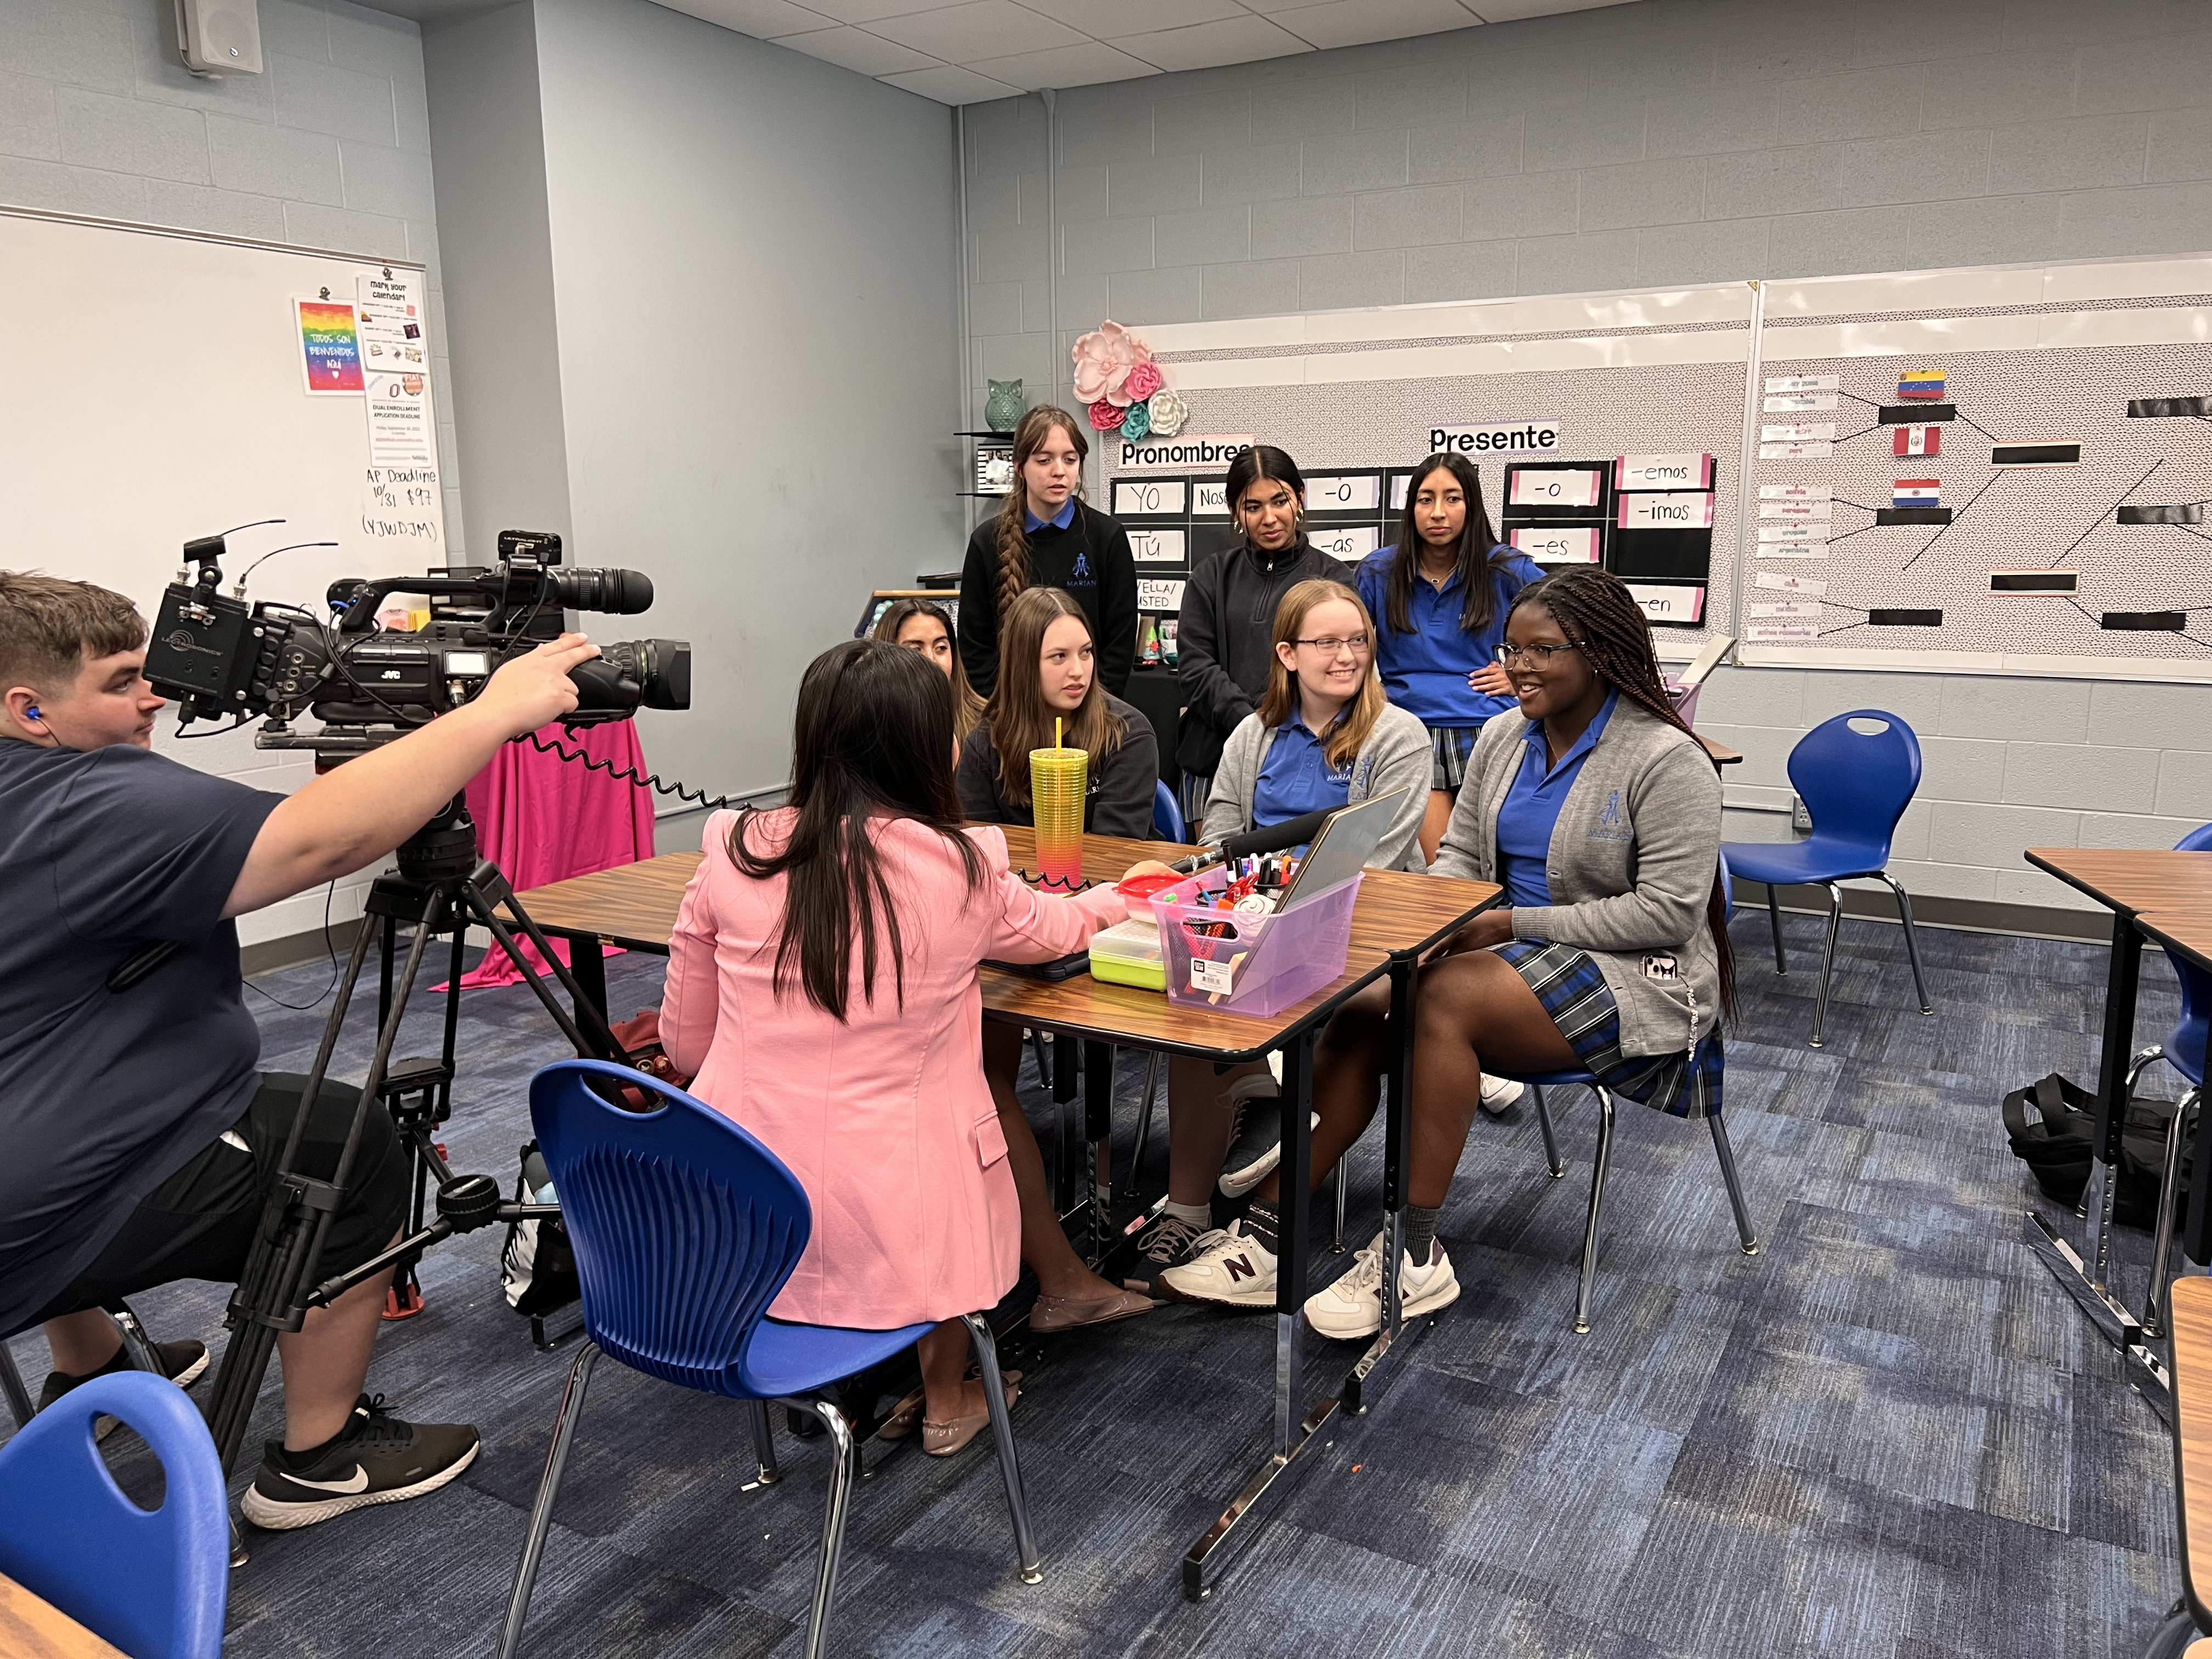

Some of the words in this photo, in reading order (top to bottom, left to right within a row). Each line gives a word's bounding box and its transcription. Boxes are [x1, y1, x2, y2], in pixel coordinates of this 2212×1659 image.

[370, 281, 389, 291] mark
[391, 283, 407, 291] your
[309, 334, 334, 343] TODOS
[336, 335, 351, 344] SON
[309, 346, 354, 357] BIENVENIDOS
[1431, 425, 1556, 452] Presente
[367, 469, 381, 483] AP
[388, 469, 436, 483] Deadline
[1631, 466, 1689, 480] -emos
[373, 483, 396, 507] 10/31
[407, 487, 432, 506] $97
[1638, 500, 1690, 521] -imos
[1131, 535, 1160, 559] Tú
[1321, 538, 1354, 552] -as
[1533, 540, 1569, 556] -es
[1637, 599, 1671, 612] -en
[381, 670, 400, 679] JVC
[1327, 773, 1351, 781] MARIA
[1222, 1253, 1257, 1283] N
